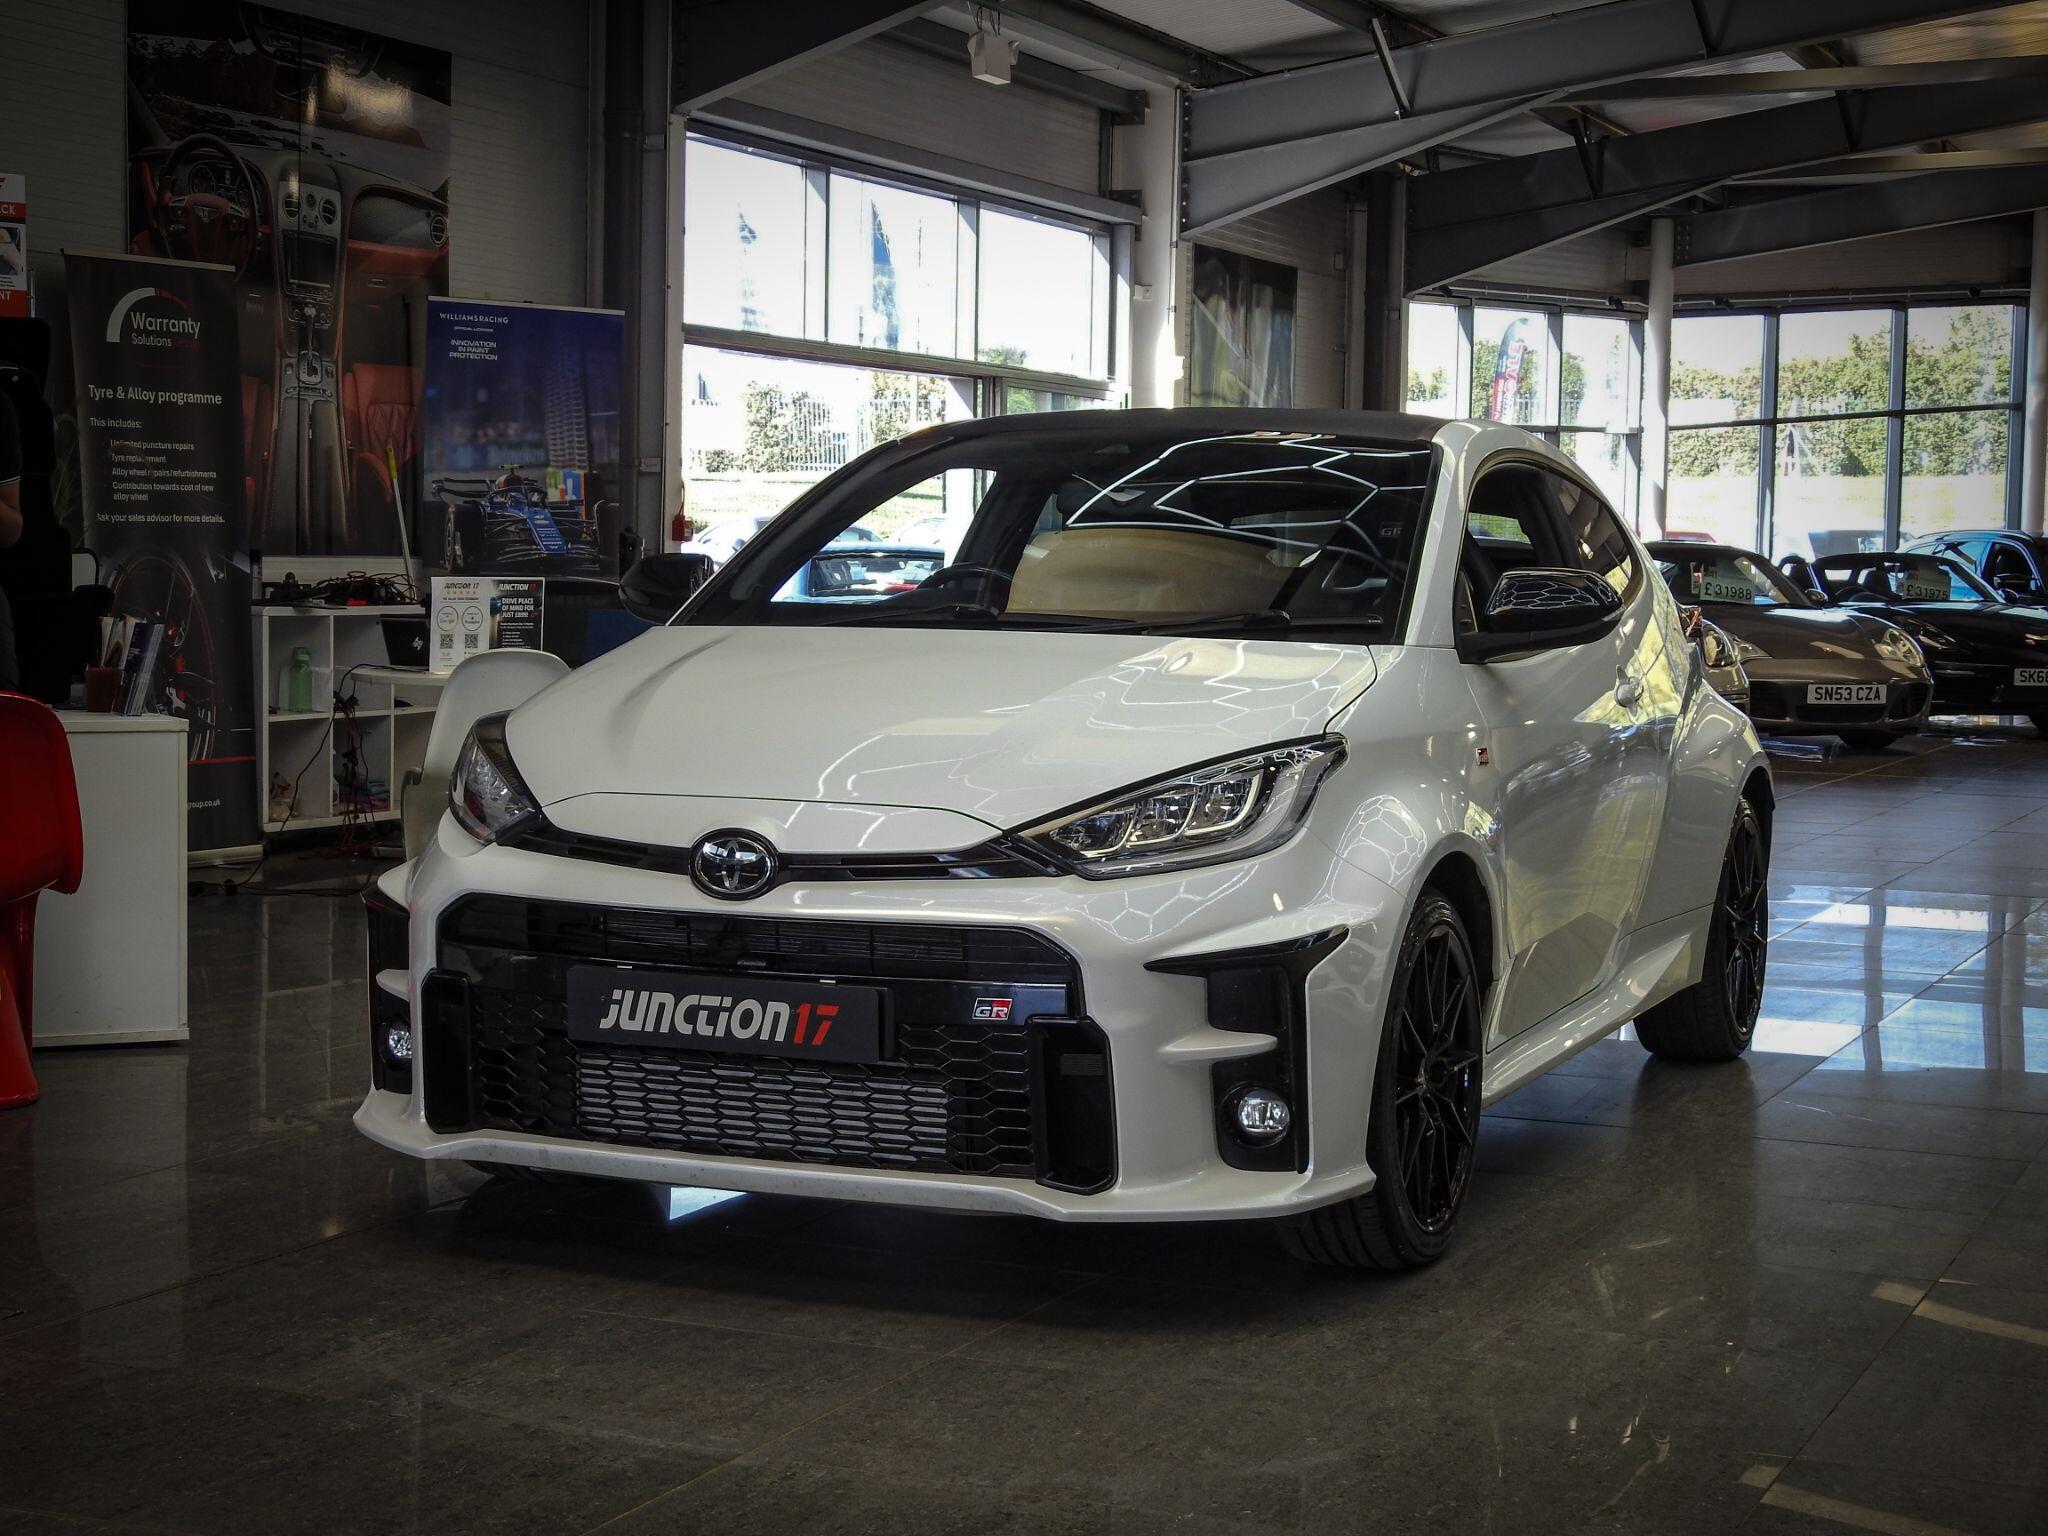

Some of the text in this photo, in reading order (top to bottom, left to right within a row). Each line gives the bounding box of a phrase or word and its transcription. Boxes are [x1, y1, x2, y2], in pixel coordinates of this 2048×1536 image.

[0, 204, 16, 215] CK
[131, 311, 201, 339] Warranty
[131, 332, 173, 347] Solutions
[450, 339, 497, 348] INNOVATION
[449, 352, 498, 361] PROTECTION
[88, 384, 223, 406] Tyre & Alloy programme
[89, 417, 142, 429] This includes:
[142, 441, 172, 451] puncture
[172, 442, 195, 451] repairs
[125, 454, 167, 464] replament
[111, 467, 129, 477] Alloy
[147, 468, 217, 479] rpairs/refurbishments
[112, 481, 153, 490] Contribution
[153, 482, 180, 491] towards
[180, 483, 194, 491] cost
[112, 492, 149, 502] alloy wheel
[110, 514, 127, 523] your
[127, 513, 145, 521] sales
[146, 513, 173, 522] advisor
[173, 514, 184, 522] for
[184, 515, 201, 523] more
[1704, 582, 1752, 600] £31988
[1814, 686, 1881, 701] SN53 CZA
[975, 1006, 1008, 1018] GR
